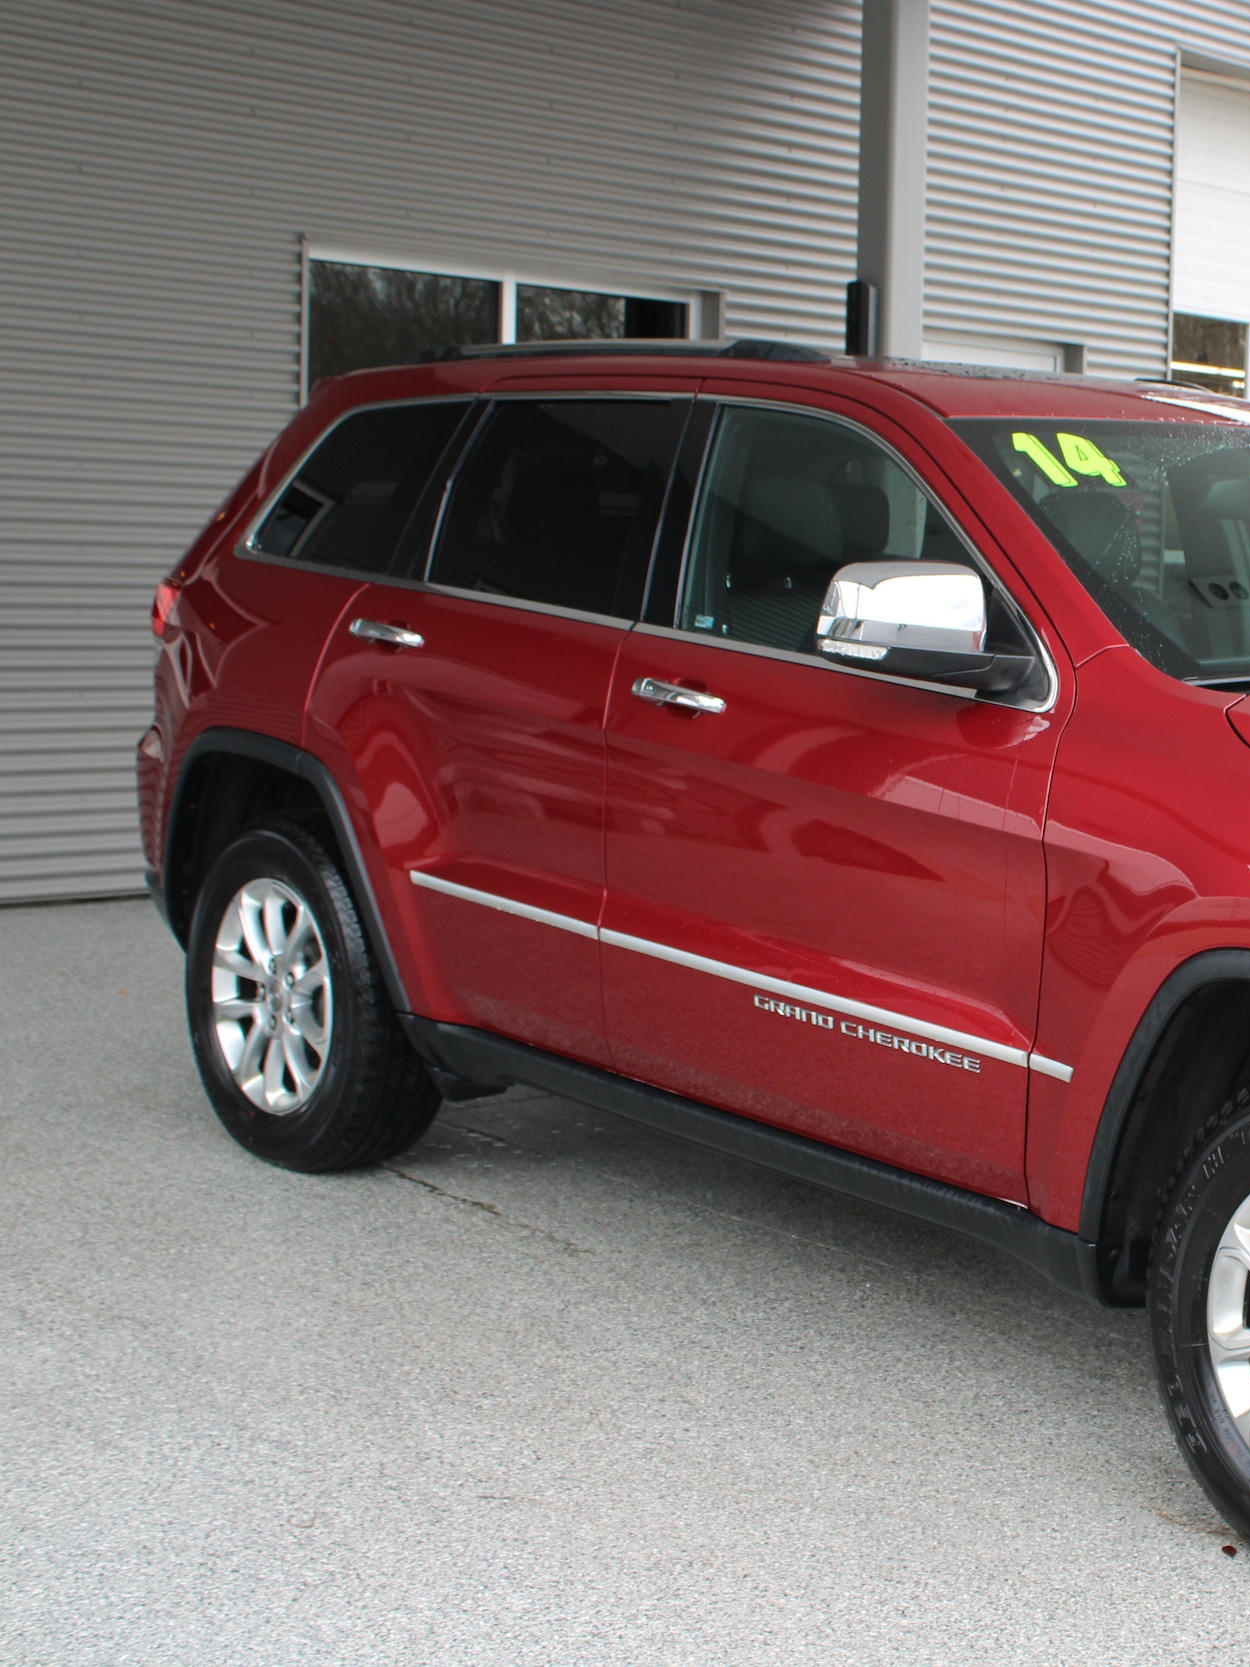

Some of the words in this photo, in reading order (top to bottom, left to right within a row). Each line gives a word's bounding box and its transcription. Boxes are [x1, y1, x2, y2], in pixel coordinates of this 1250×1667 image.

[1011, 431, 1128, 487] 14
[753, 994, 834, 1030] GRAND
[839, 1020, 981, 1074] CHEROKEE
